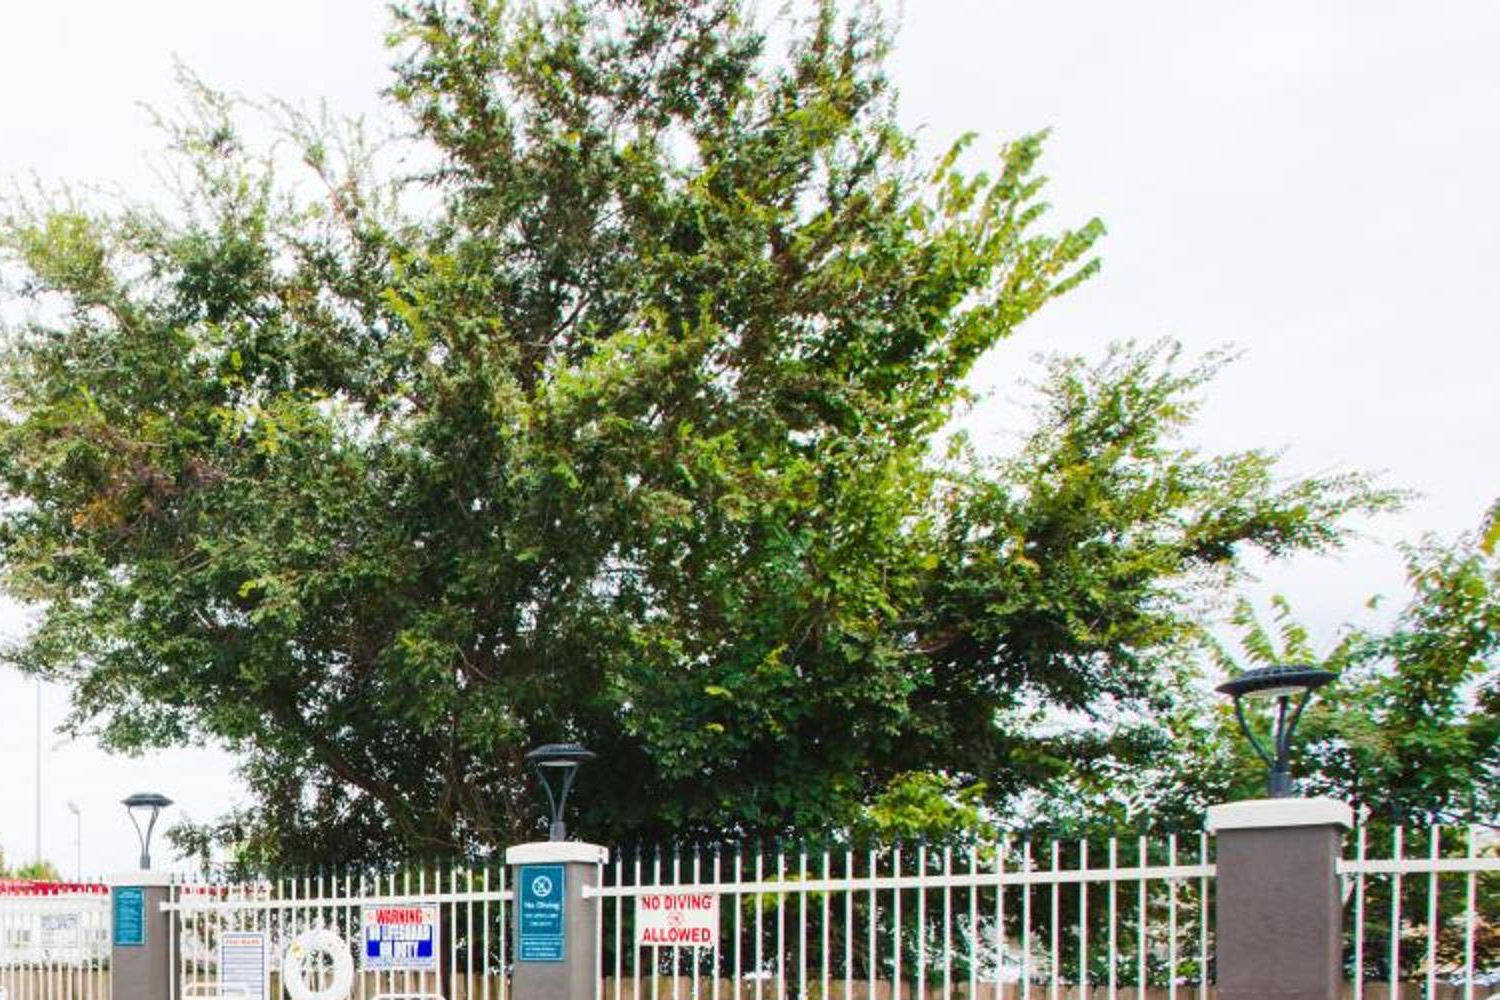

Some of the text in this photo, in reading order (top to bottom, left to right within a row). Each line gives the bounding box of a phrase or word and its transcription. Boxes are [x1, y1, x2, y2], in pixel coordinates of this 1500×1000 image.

[642, 895, 712, 910] NO DIVING
[376, 909, 422, 925] WARNING
[643, 928, 711, 942] ALLOWED
